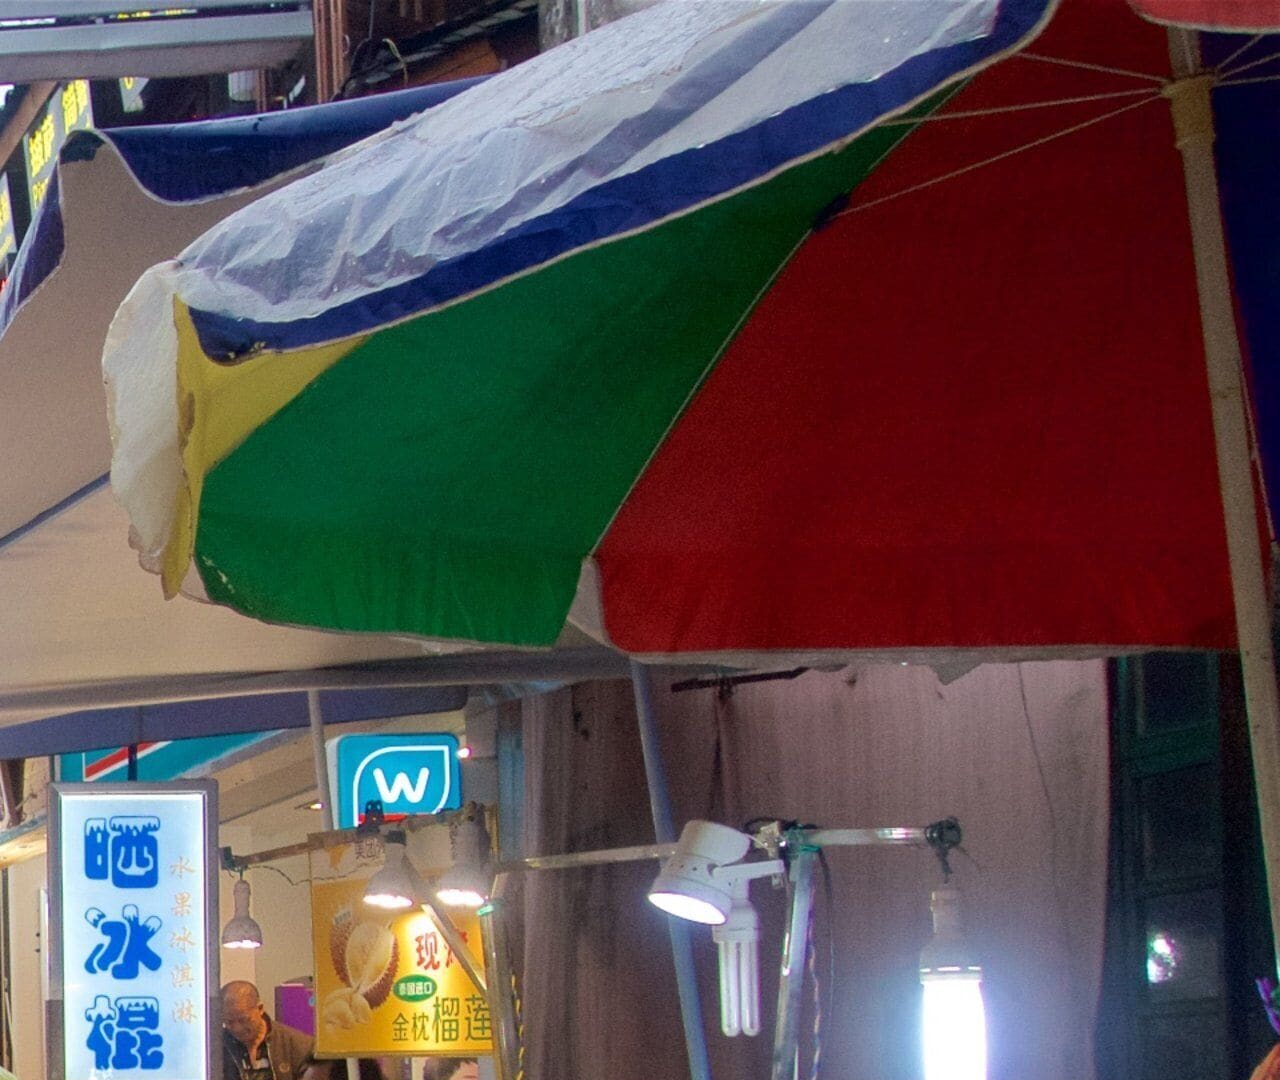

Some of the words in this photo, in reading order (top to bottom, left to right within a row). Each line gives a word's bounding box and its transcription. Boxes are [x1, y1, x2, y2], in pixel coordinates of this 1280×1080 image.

[374, 766, 429, 803] W
[84, 816, 164, 1070] 晒冰棍
[169, 856, 198, 1025] 水果冰淇淋
[392, 994, 492, 1044] 金枕榴莲
